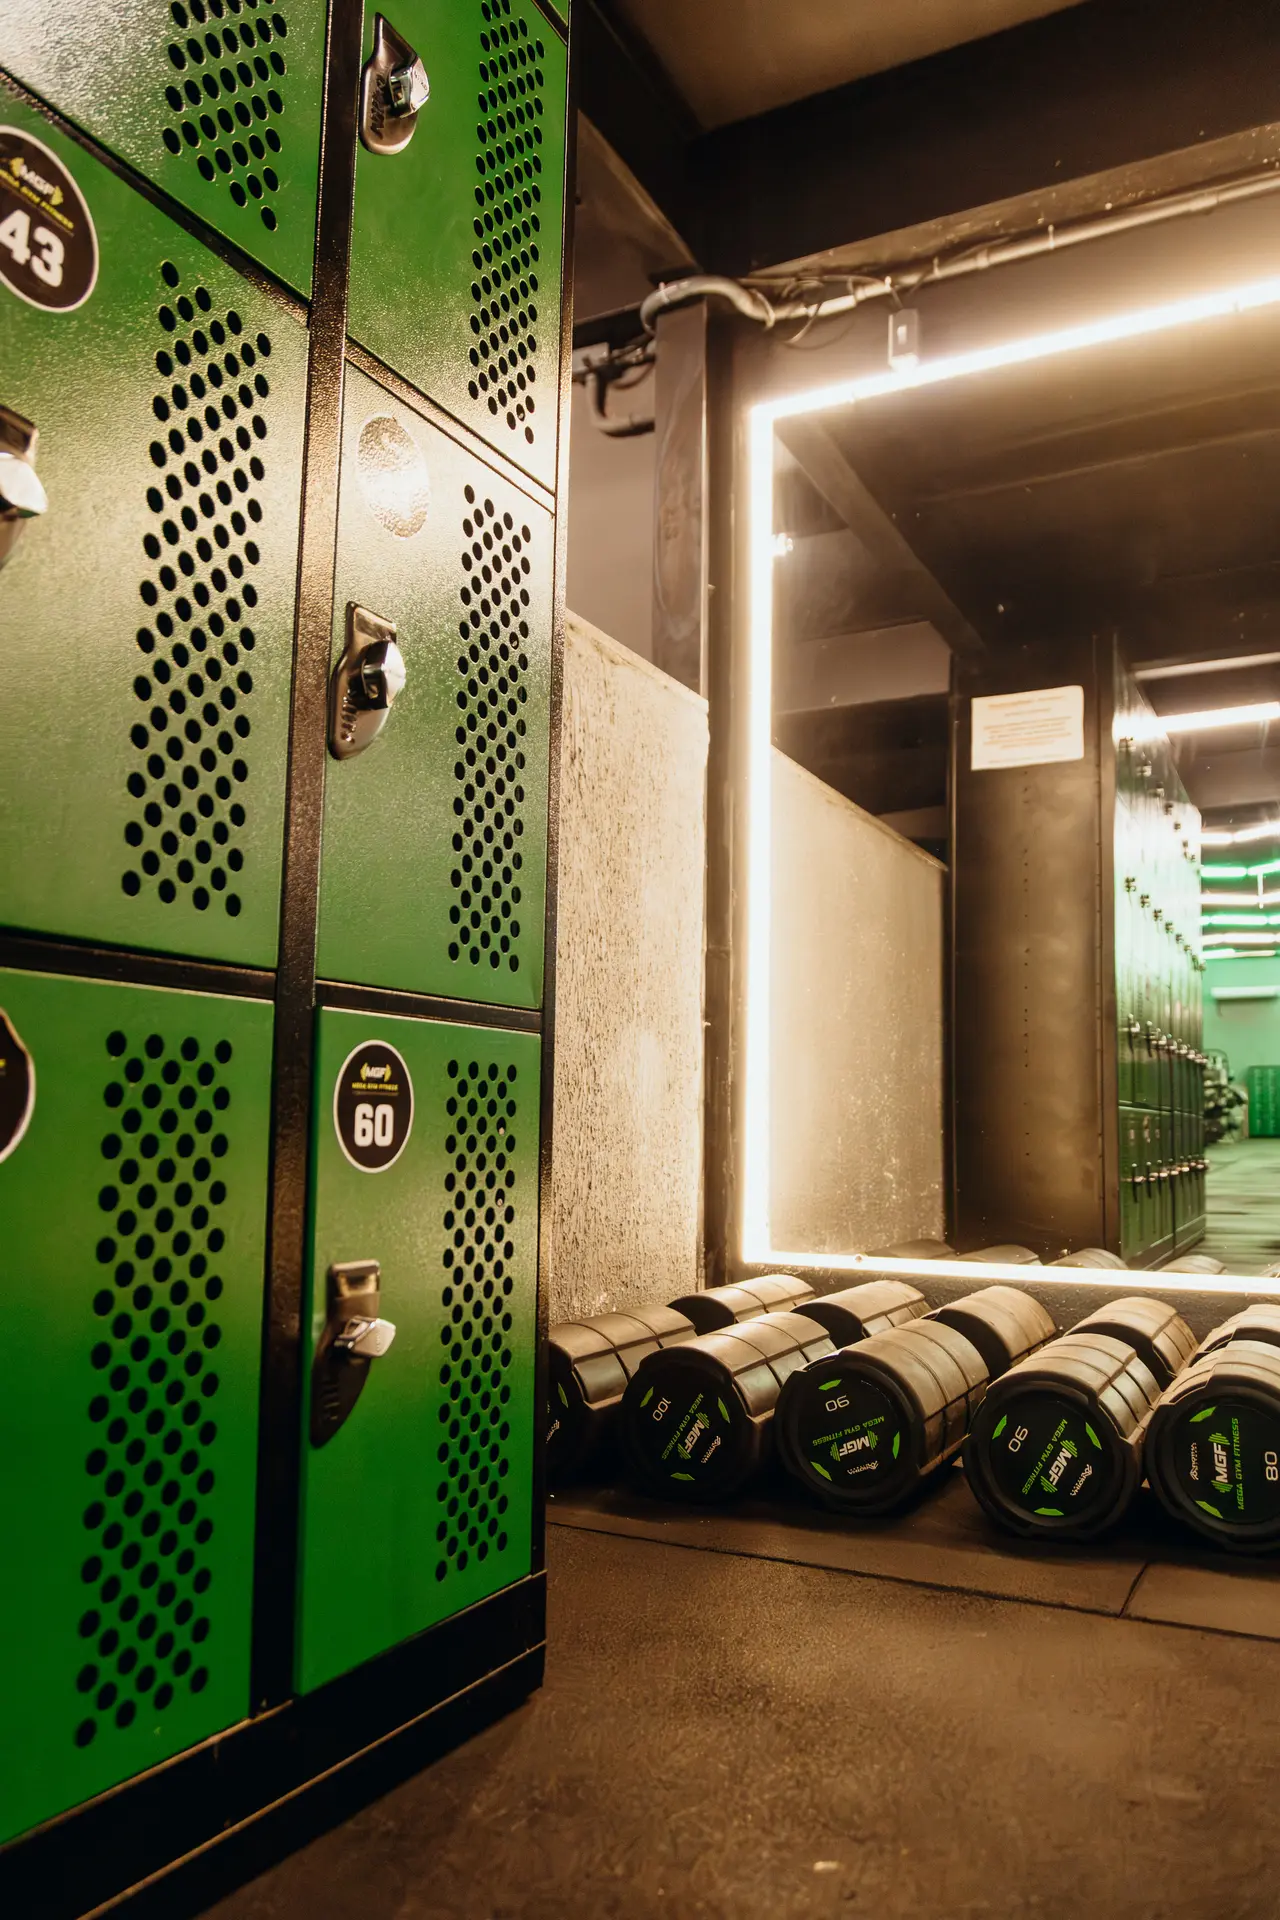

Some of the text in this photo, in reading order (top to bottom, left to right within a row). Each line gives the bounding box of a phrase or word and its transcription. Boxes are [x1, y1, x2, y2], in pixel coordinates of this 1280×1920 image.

[0, 209, 64, 287] 43
[365, 1066, 387, 1078] MGF
[354, 1103, 394, 1147] 60
[652, 1397, 671, 1421] 100
[825, 1395, 850, 1412] 90
[661, 1393, 704, 1460] MEGA GYM FITNESS
[684, 1419, 705, 1453] MGF
[812, 1415, 885, 1446] MEGA GYM FITNESS
[1008, 1425, 1028, 1453] 90
[839, 1435, 870, 1457] MGF
[1021, 1419, 1068, 1495] MEGA GYM FITNESS
[1213, 1442, 1229, 1483] MGF
[1048, 1447, 1072, 1486] MGF
[1231, 1417, 1244, 1510] MEGA GYM FITNESS
[1264, 1451, 1279, 1482] 80
